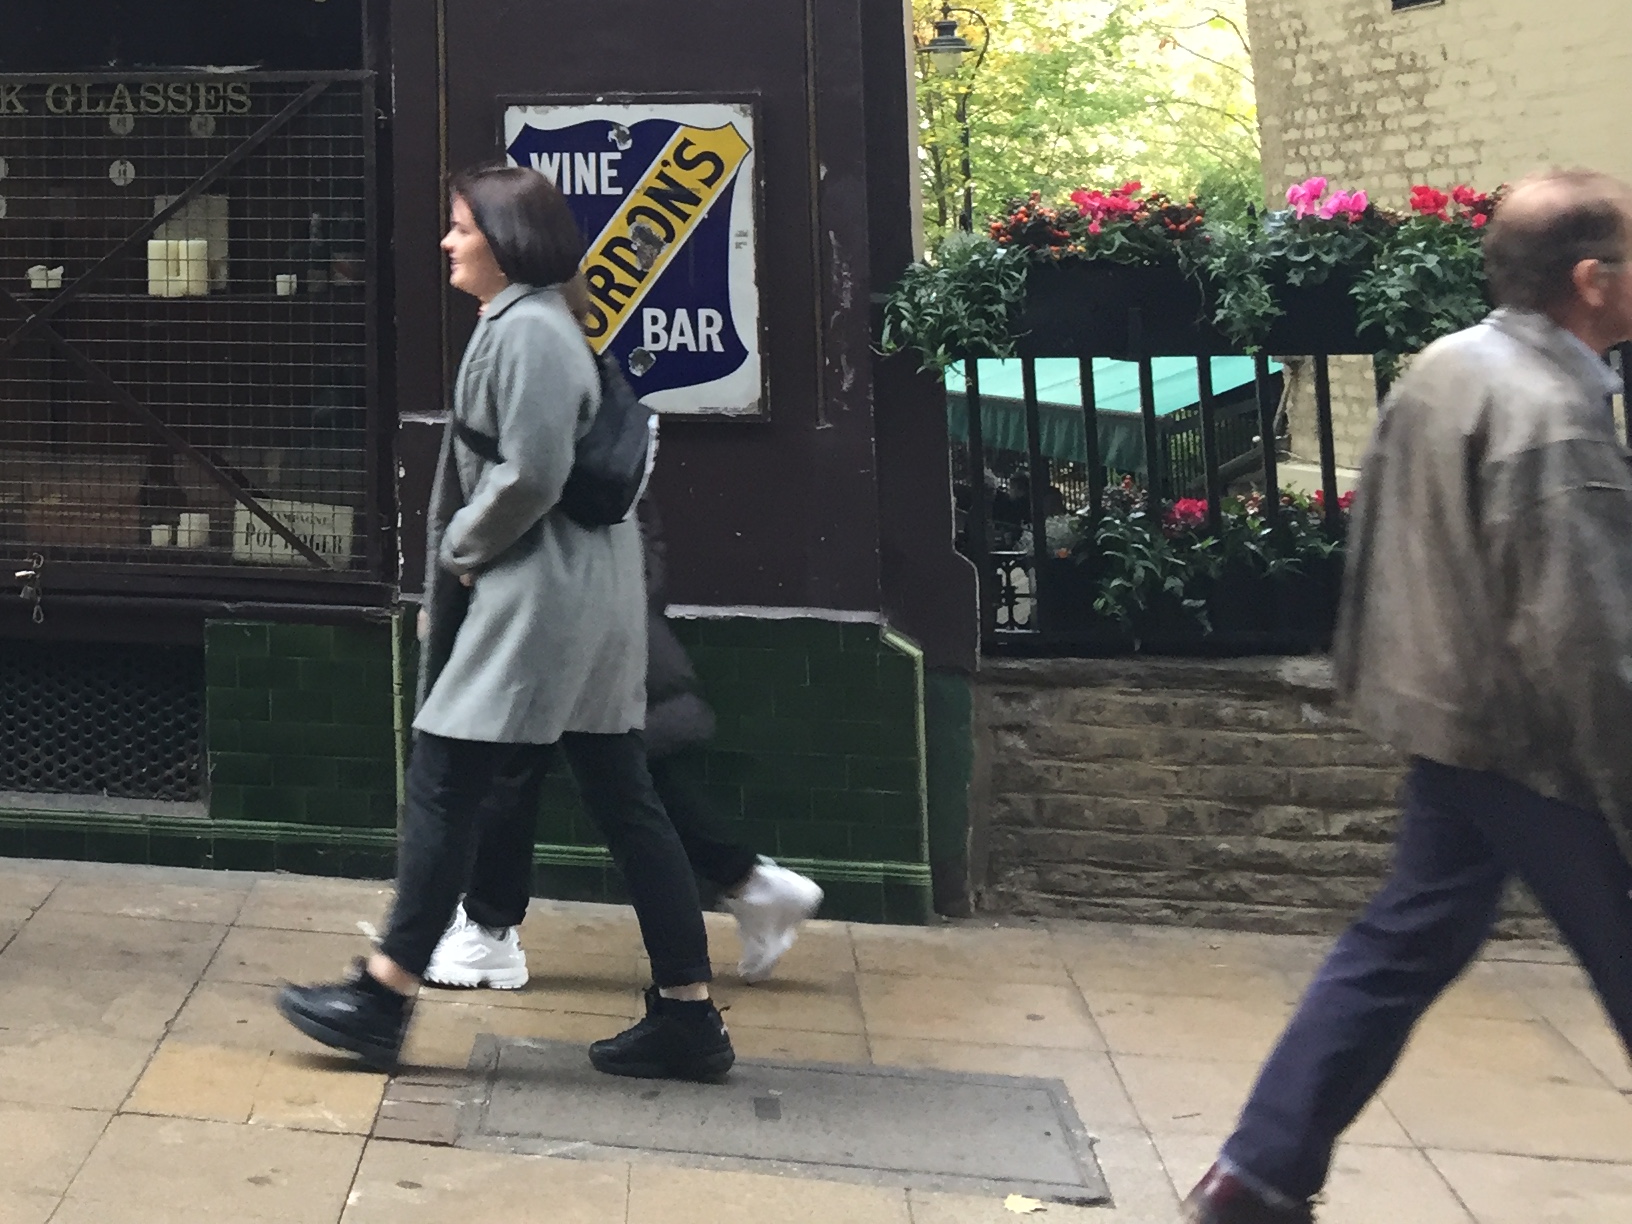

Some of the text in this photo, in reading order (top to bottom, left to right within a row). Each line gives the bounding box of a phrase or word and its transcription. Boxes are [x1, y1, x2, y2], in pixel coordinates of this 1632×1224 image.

[44, 81, 254, 115] GLASSES
[529, 151, 623, 196] WINE
[583, 137, 725, 338] ORDON'S
[642, 308, 725, 353] BAR
